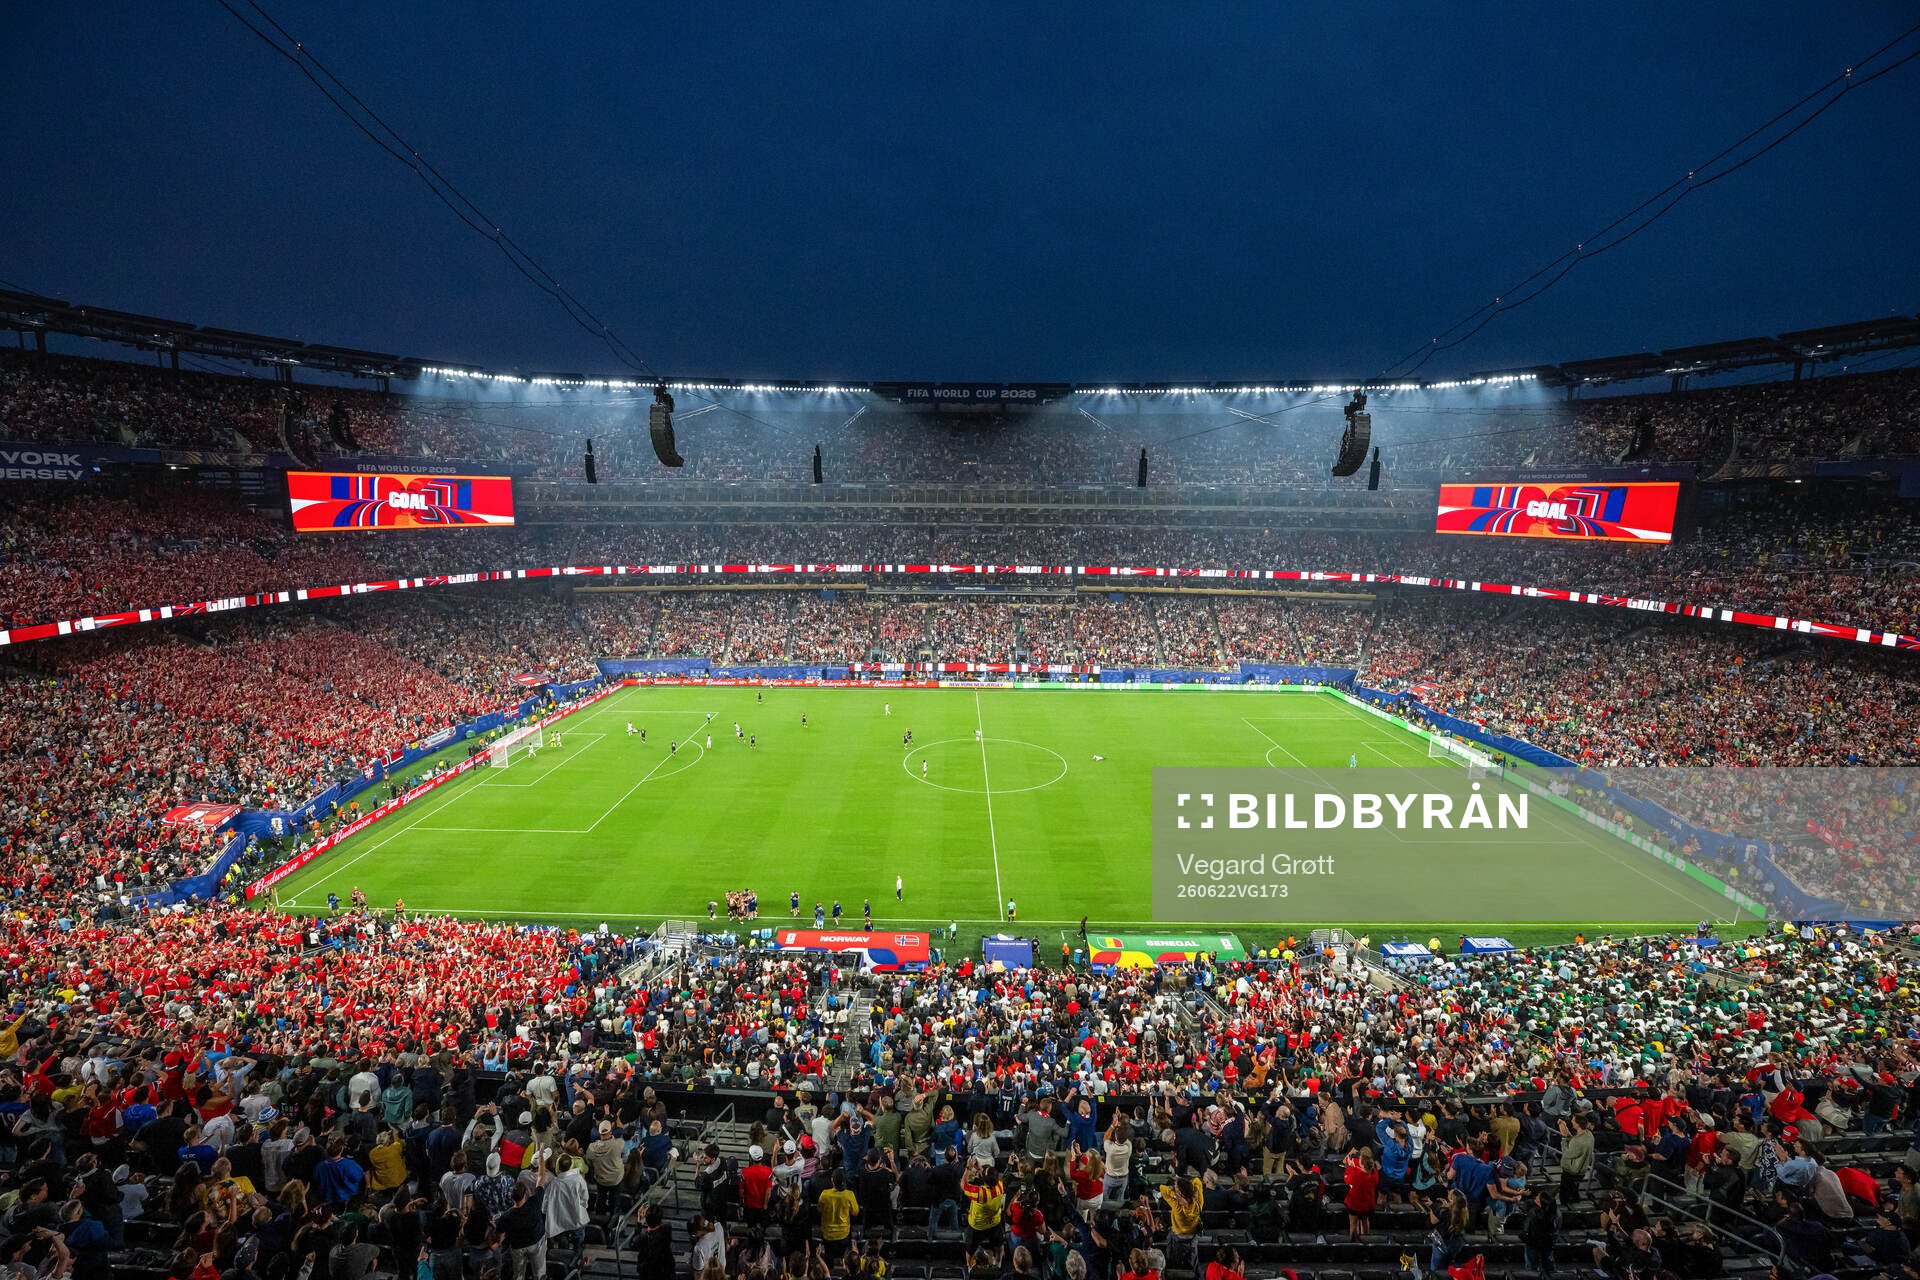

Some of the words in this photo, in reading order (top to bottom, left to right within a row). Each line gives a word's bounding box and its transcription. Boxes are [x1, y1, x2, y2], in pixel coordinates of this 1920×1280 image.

[907, 389, 929, 398] FIFA
[933, 389, 970, 398] WORLD
[976, 389, 997, 398] CUP
[1000, 390, 1037, 398] 2026
[0, 451, 82, 466] YORK
[357, 464, 377, 472] FIFA
[429, 466, 457, 474] 2026
[388, 491, 428, 510] GOAL
[1526, 500, 1568, 520] GOAL
[820, 935, 870, 943] NORWAY
